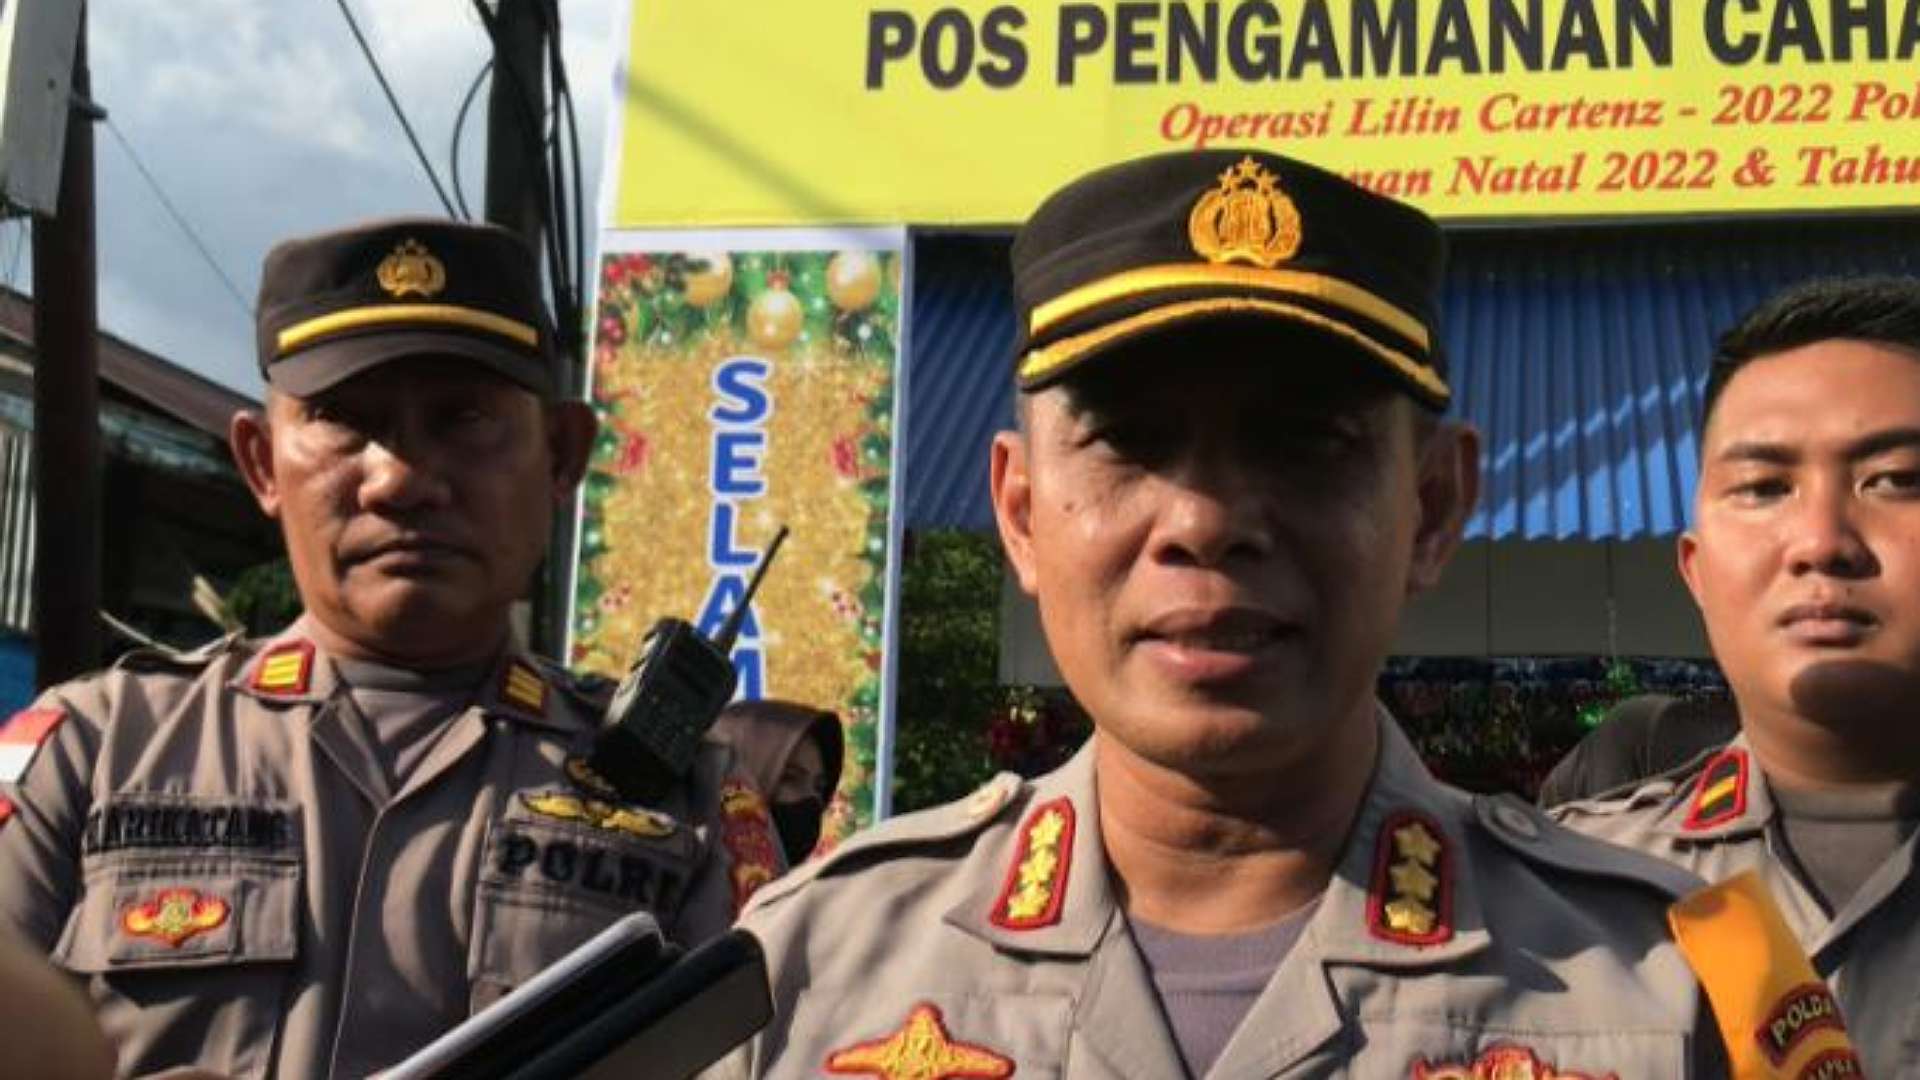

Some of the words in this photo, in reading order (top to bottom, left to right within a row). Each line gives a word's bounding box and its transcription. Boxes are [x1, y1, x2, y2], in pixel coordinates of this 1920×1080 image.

[866, 5, 1029, 90] POS
[1057, 0, 1673, 87] PENGAMANAN
[1161, 100, 1334, 151] Operasi
[1344, 96, 1460, 137] Lilin
[1478, 92, 1664, 135] Cartenz
[1711, 82, 1832, 125] 2022
[1445, 151, 1586, 196] Natal
[1599, 148, 1718, 191] 2022
[1732, 147, 1777, 187] &
[1797, 143, 1920, 186] Tahu
